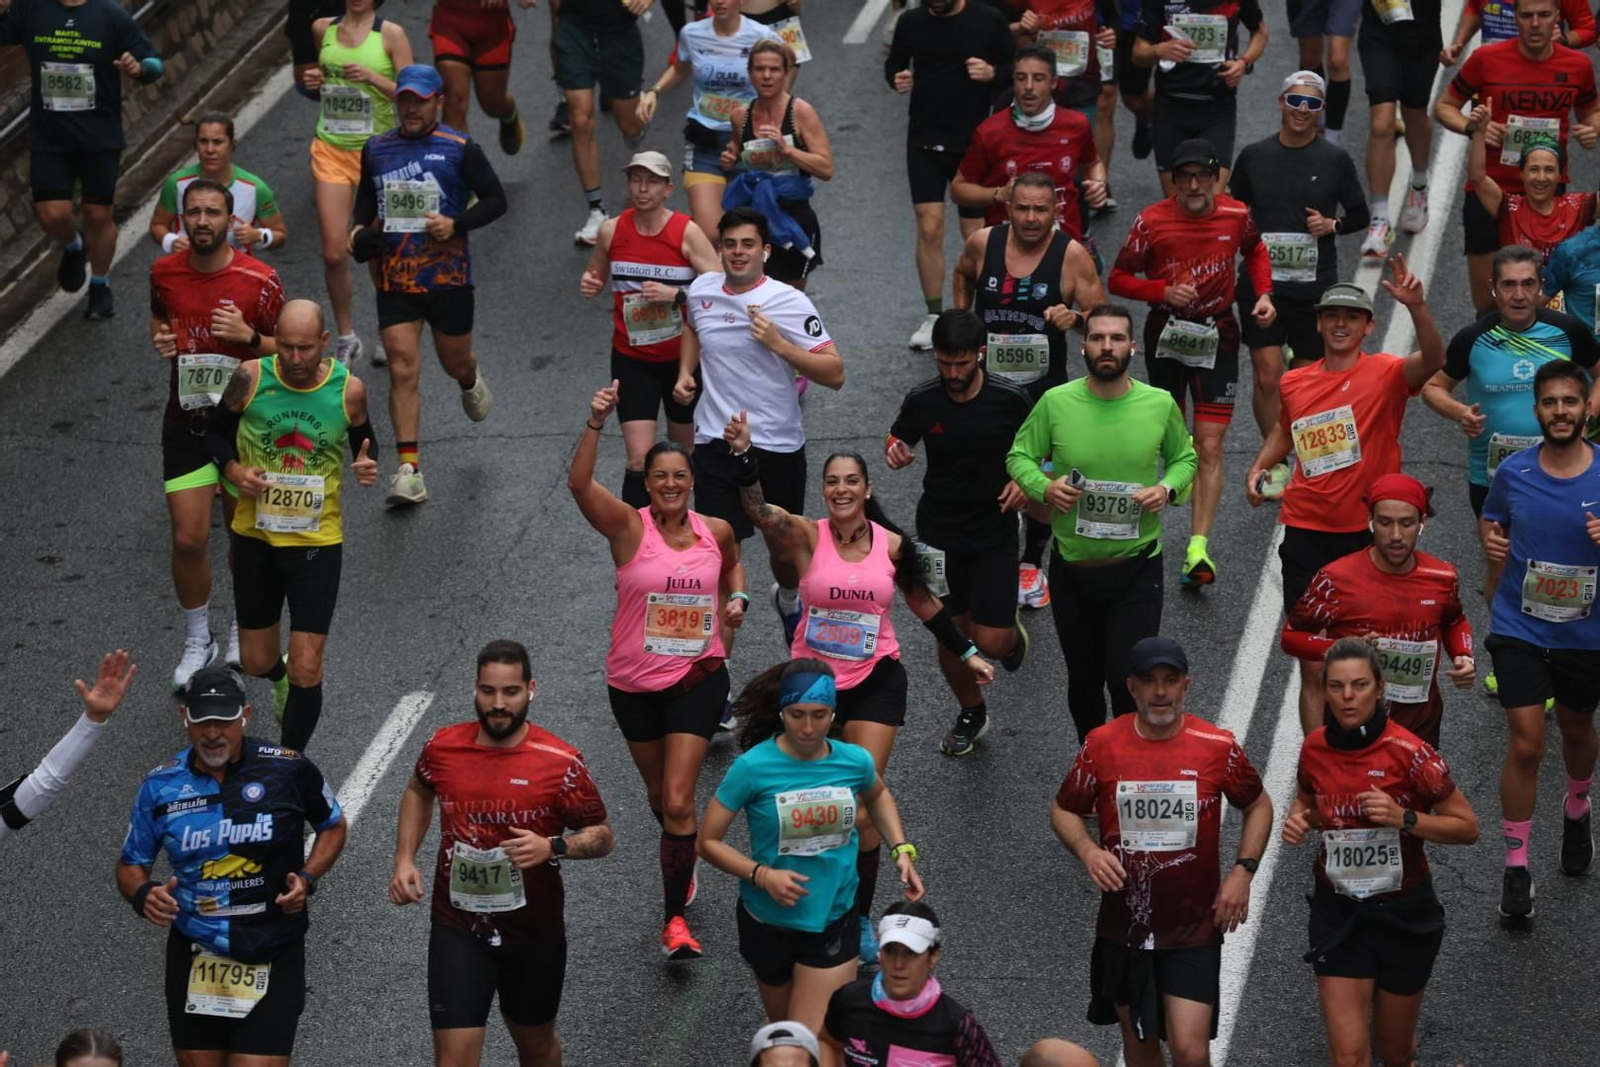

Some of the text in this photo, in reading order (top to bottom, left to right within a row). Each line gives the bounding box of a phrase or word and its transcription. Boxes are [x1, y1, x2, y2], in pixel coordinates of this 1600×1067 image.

[48, 75, 82, 90] 8582
[325, 97, 363, 112] 10429
[1501, 90, 1574, 112] KENYA
[424, 153, 446, 161] HOKA
[391, 194, 425, 209] 9496
[1269, 246, 1305, 261] 6517
[614, 263, 677, 279] Swinton R.C.
[808, 319, 821, 336] JD
[984, 308, 1045, 331] OLYMPUS
[1169, 332, 1205, 350] 8641
[996, 348, 1035, 364] 8596
[188, 367, 223, 386] 7870
[267, 410, 322, 430] RUNNERS
[1298, 422, 1347, 451] 12833
[262, 488, 314, 508] 12870
[1086, 494, 1128, 514] 9378
[665, 576, 702, 593] JULIA
[829, 586, 875, 602] DUNIA
[1535, 576, 1579, 599] 7023
[656, 608, 700, 629] 3819
[1180, 769, 1198, 777] HOKA
[791, 804, 838, 829] 9430
[1123, 798, 1185, 820] 18024
[1333, 844, 1389, 867] 18025
[459, 862, 502, 885] 9417
[215, 876, 265, 892] ALQUILERES
[198, 961, 256, 987] 11795
